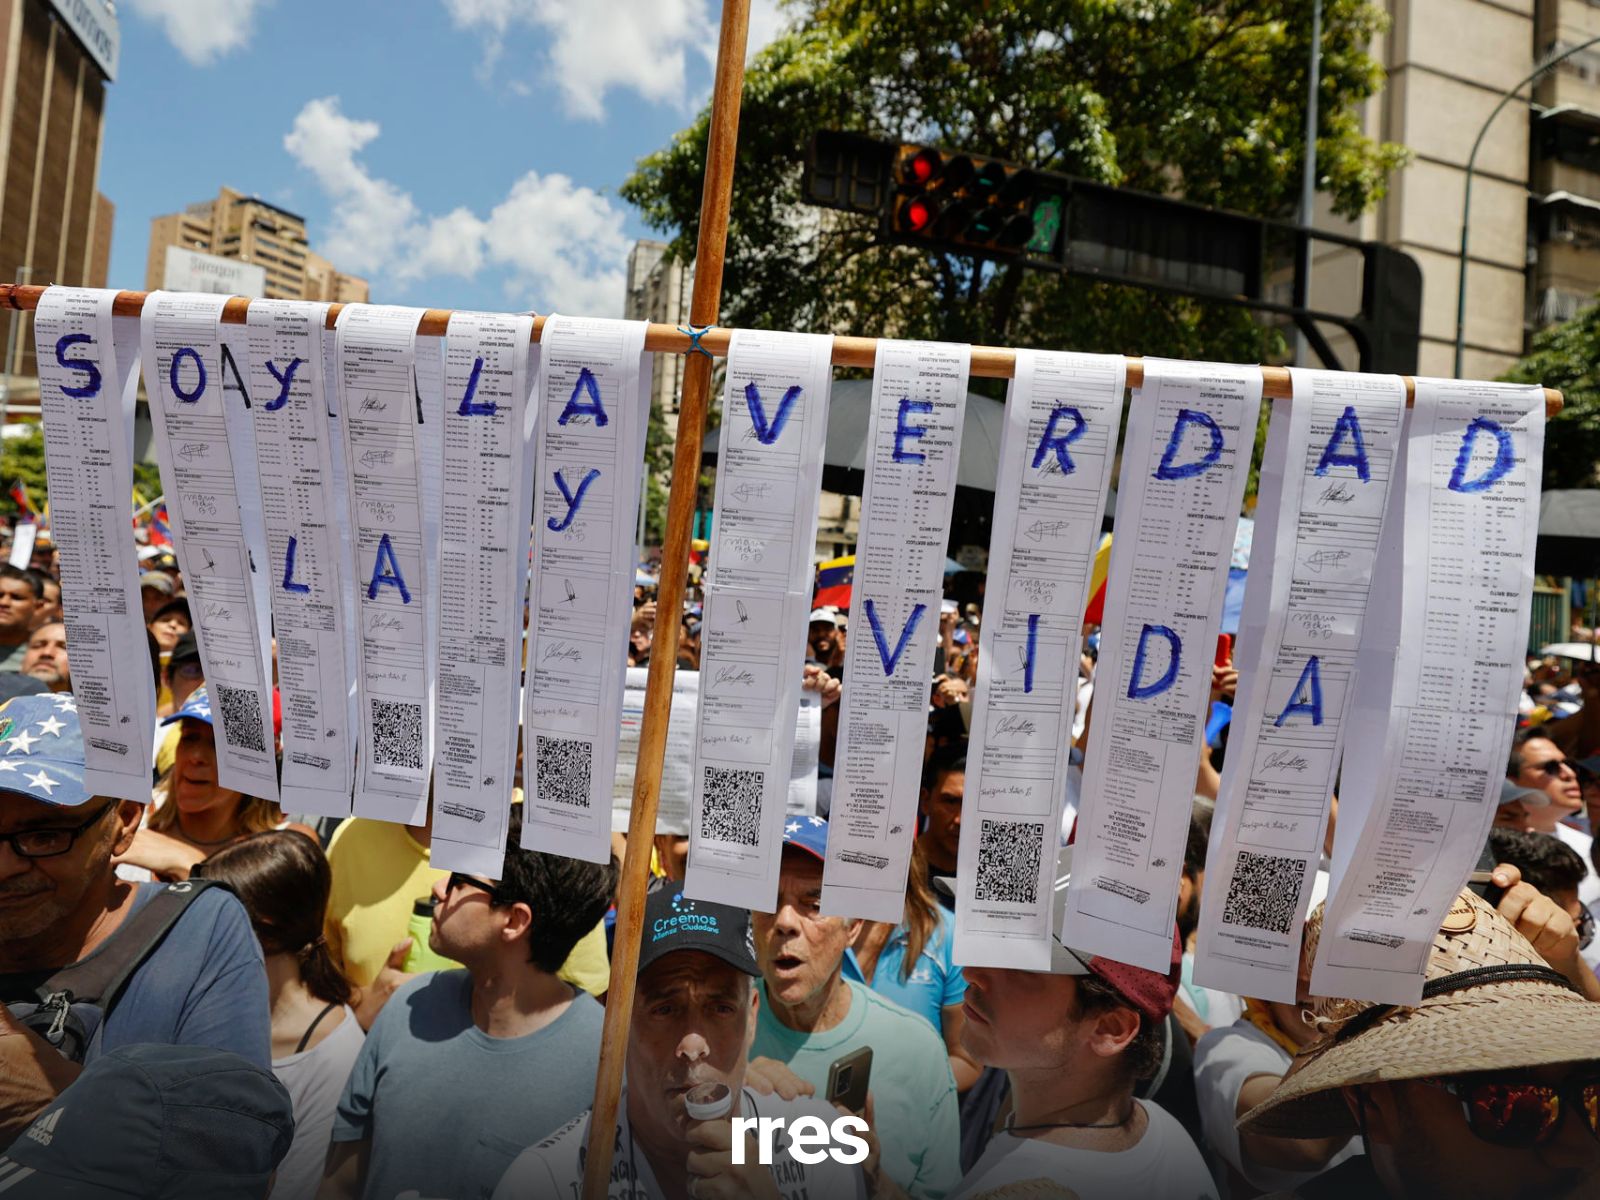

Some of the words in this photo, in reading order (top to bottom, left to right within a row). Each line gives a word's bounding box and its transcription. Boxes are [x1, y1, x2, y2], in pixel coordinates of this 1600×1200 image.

[458, 358, 609, 428] LA
[744, 383, 1517, 494] VERDAD
[863, 600, 1325, 726] VIDA
[653, 914, 717, 932] Creemos
